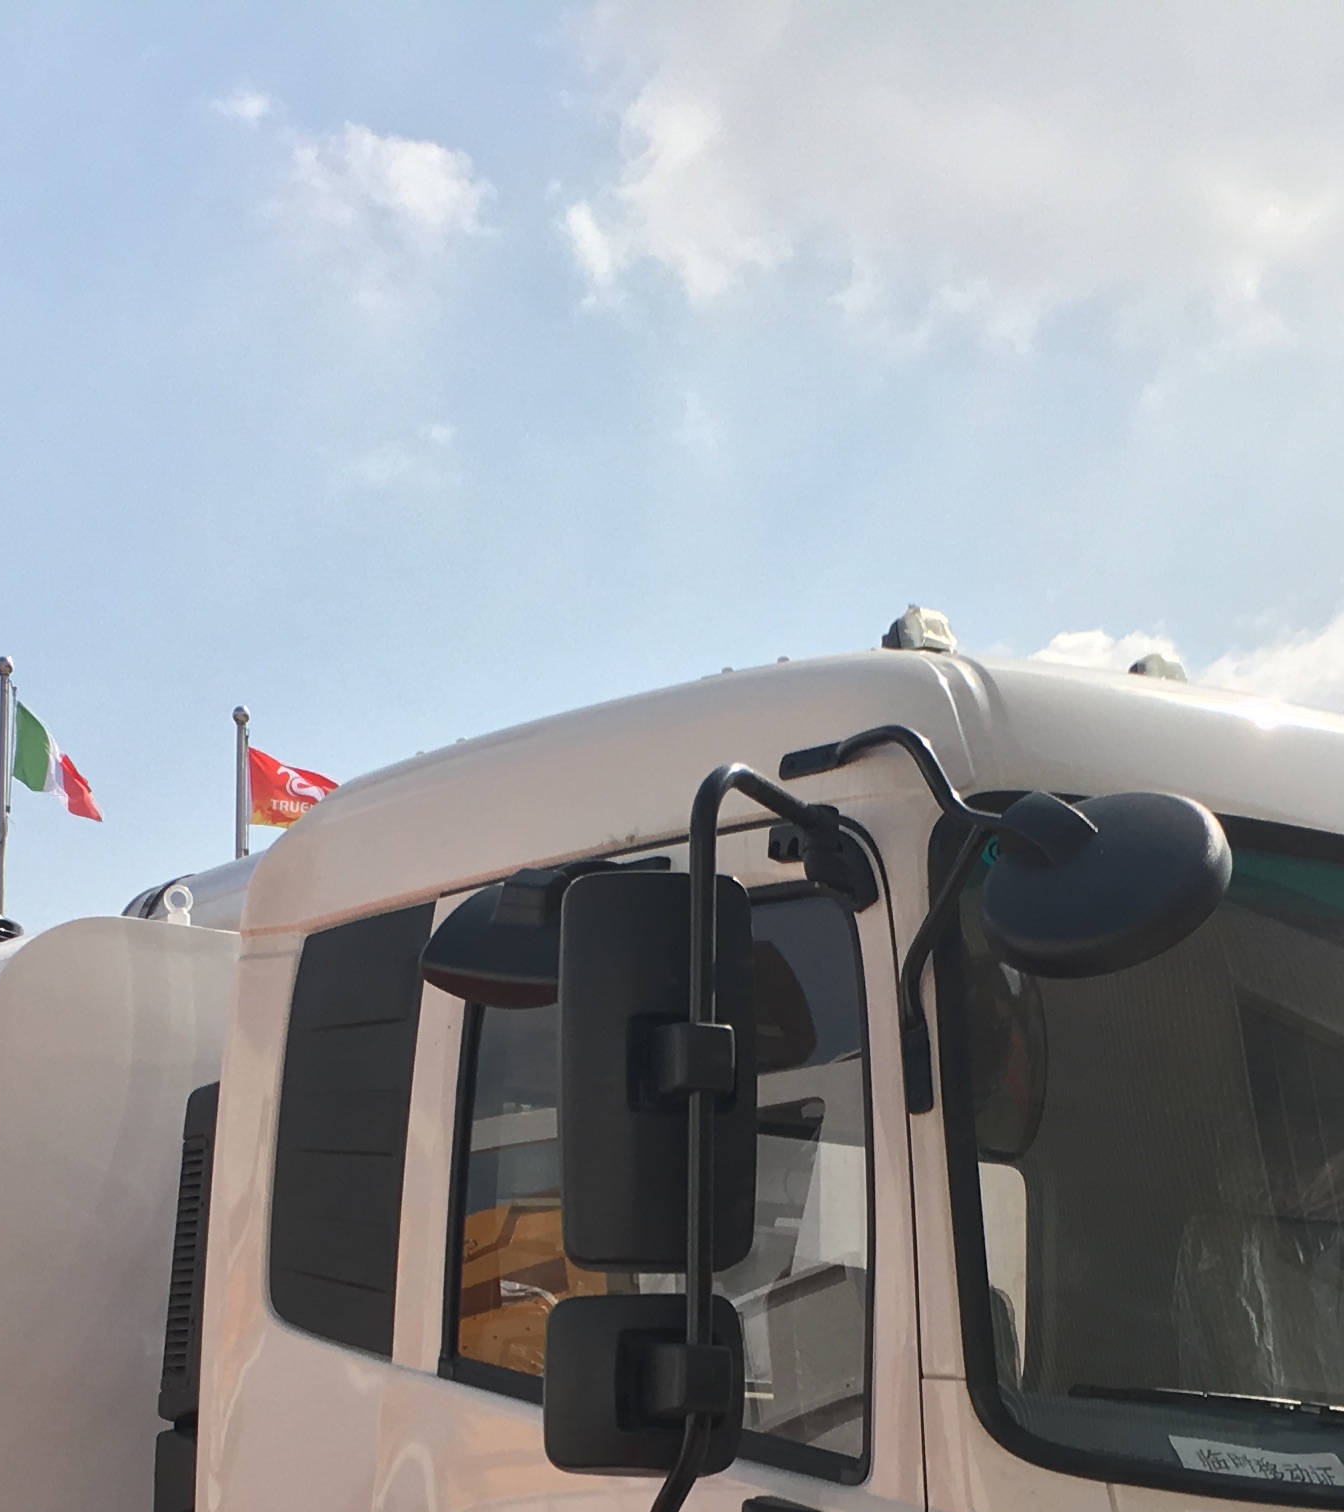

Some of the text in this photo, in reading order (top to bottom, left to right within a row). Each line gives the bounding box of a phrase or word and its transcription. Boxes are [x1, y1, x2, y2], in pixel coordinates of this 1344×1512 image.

[270, 798, 316, 814] TRUE
[1196, 1448, 1336, 1486] 临时移动证
